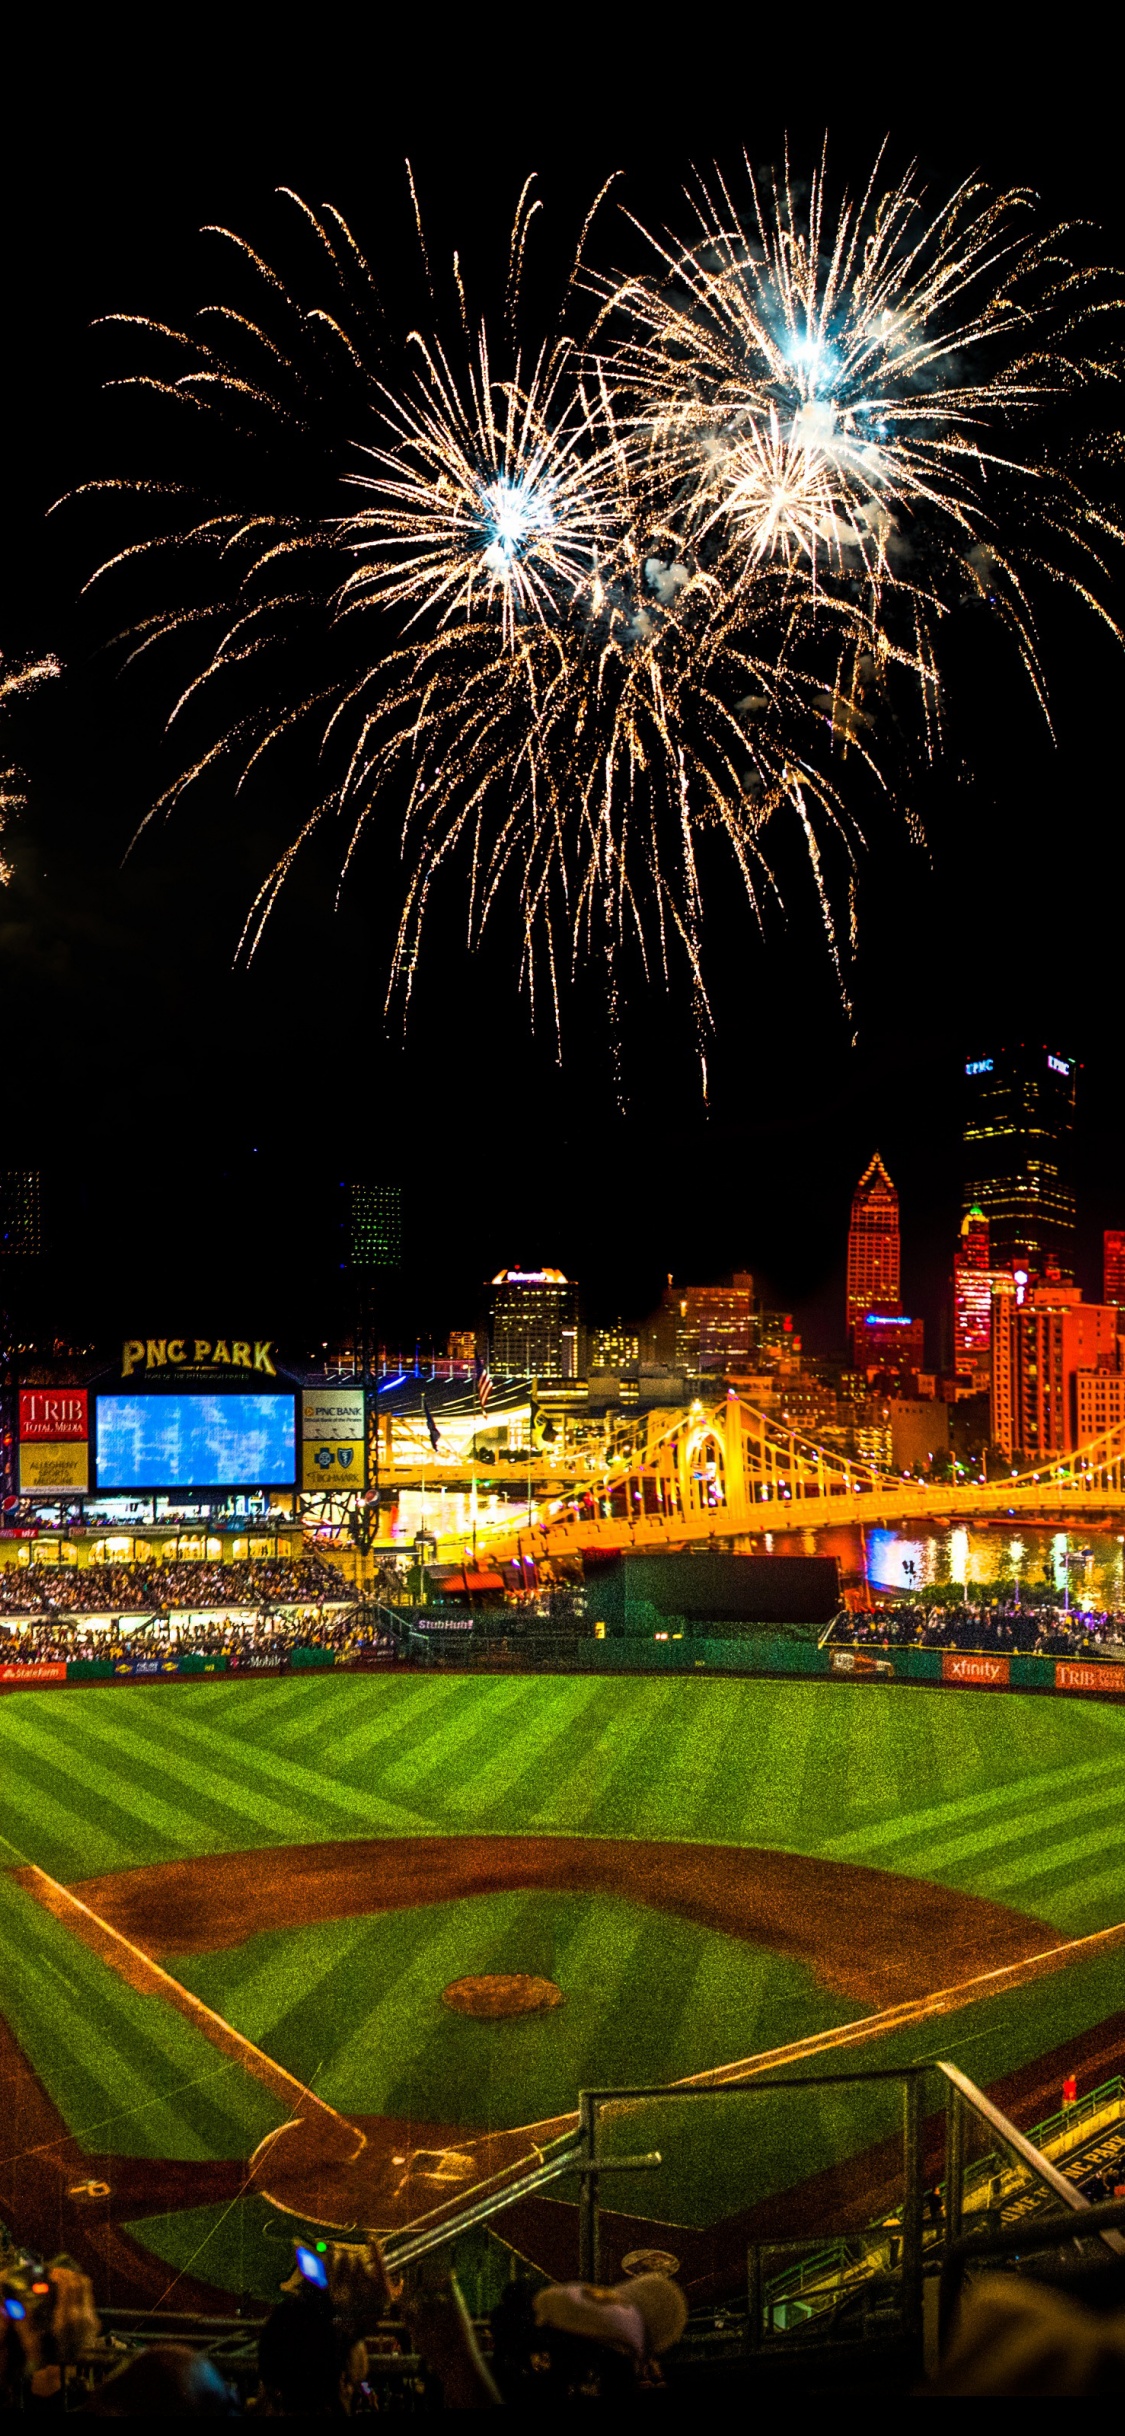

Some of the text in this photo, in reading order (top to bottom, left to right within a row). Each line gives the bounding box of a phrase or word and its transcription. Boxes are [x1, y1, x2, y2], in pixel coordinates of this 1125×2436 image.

[966, 1059, 993, 1075] UPMC
[121, 1339, 277, 1377] PNC PARK
[22, 1395, 83, 1420] TRIB
[315, 1407, 362, 1416] PNC BANK
[418, 1619, 474, 1630] StubHub!
[951, 1660, 1000, 1679] xfinity
[1056, 1666, 1095, 1686] TRIB
[1083, 2135, 1125, 2164] PARK
